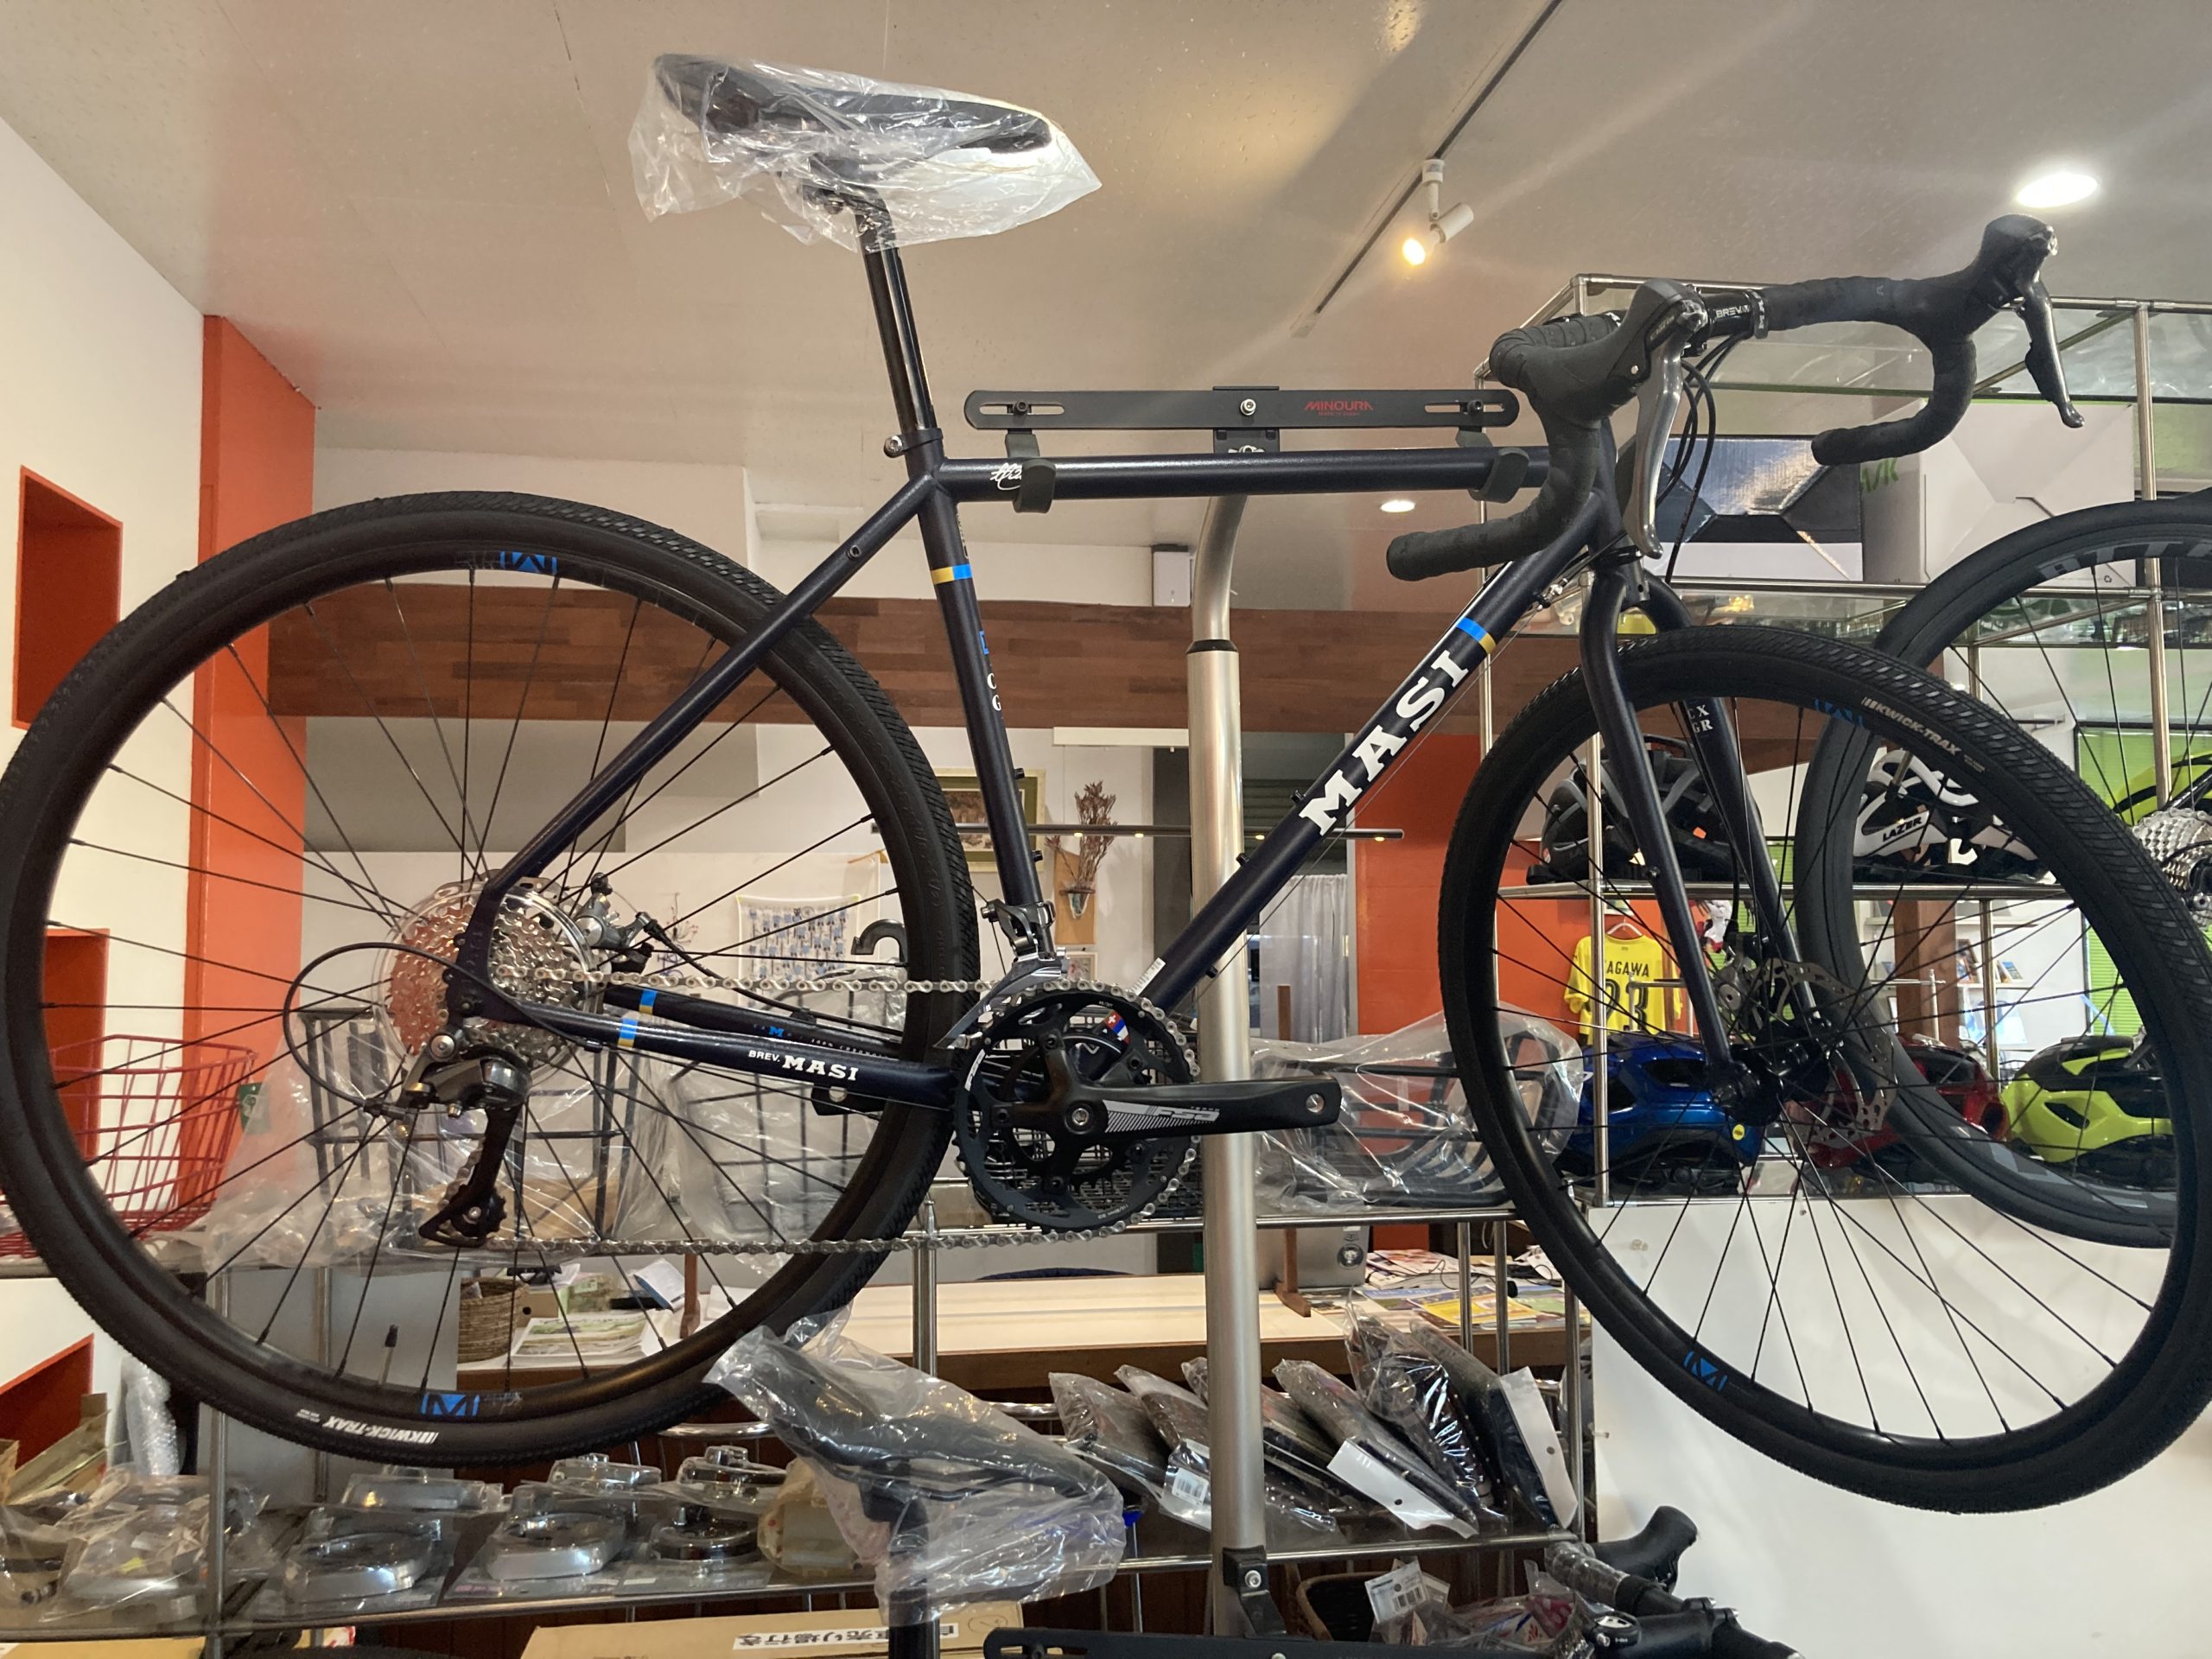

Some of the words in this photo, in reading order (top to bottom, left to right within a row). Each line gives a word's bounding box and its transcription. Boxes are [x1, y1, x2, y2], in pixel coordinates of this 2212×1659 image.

[1304, 401, 1374, 410] MINOURA
[1299, 650, 1469, 836] MASI
[1883, 817, 1922, 842] LAZER
[1605, 960, 1649, 977] AGAWA
[748, 1049, 780, 1063] BREV.
[782, 1054, 859, 1081] MASI
